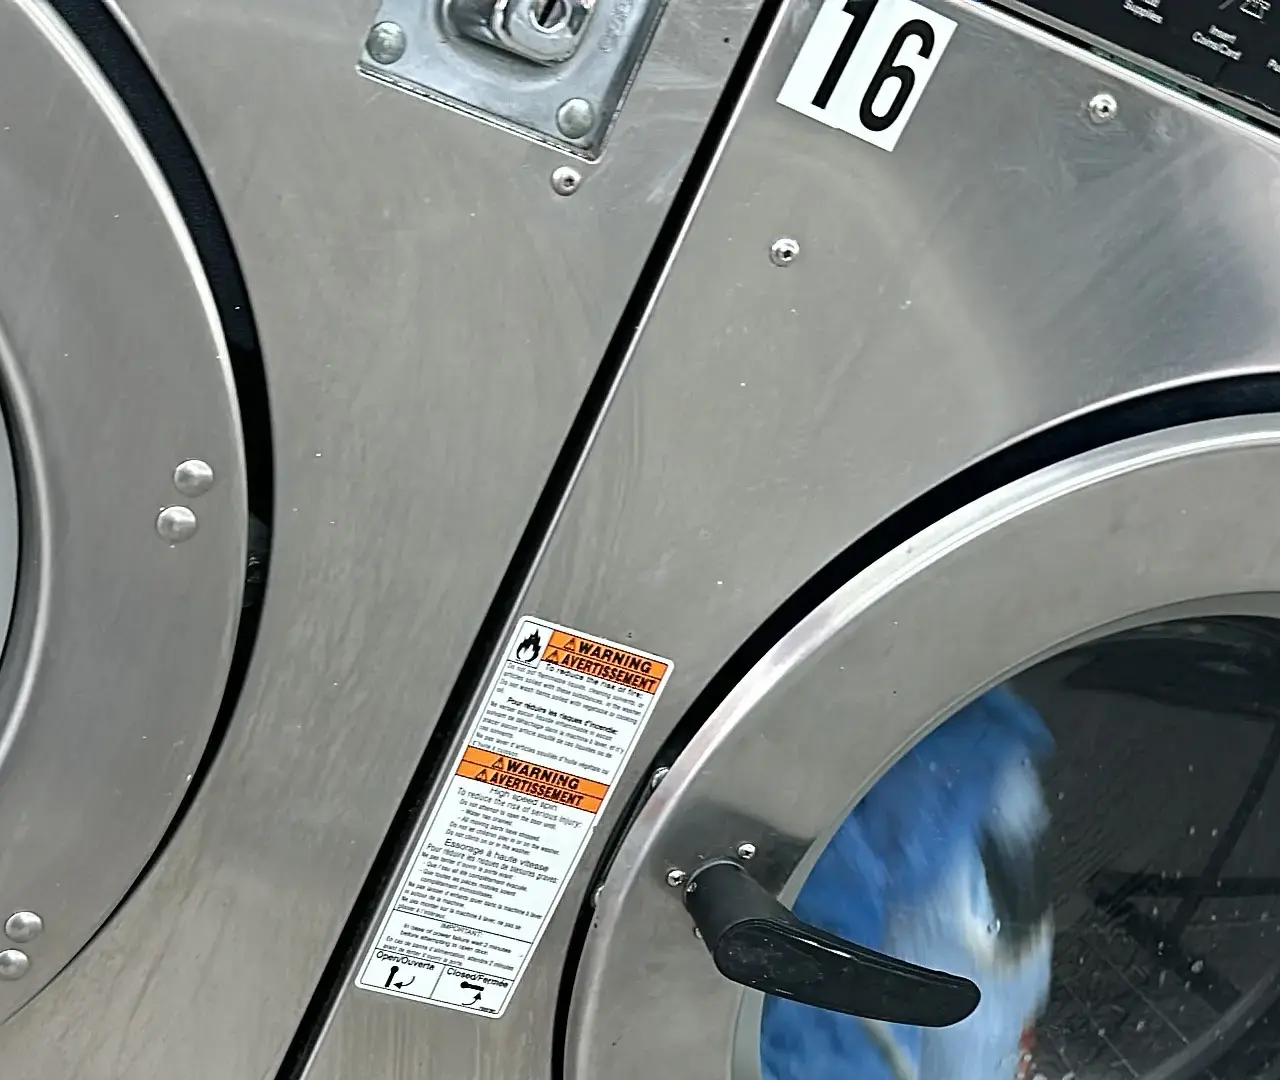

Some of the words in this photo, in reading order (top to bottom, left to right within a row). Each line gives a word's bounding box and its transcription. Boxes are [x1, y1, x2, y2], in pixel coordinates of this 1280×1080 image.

[811, 0, 935, 131] 16
[560, 653, 656, 691] AVERTISSEMENT
[577, 641, 653, 673] WARNING
[488, 771, 584, 806] AVERTISSEMENT
[504, 759, 581, 790] WARNING
